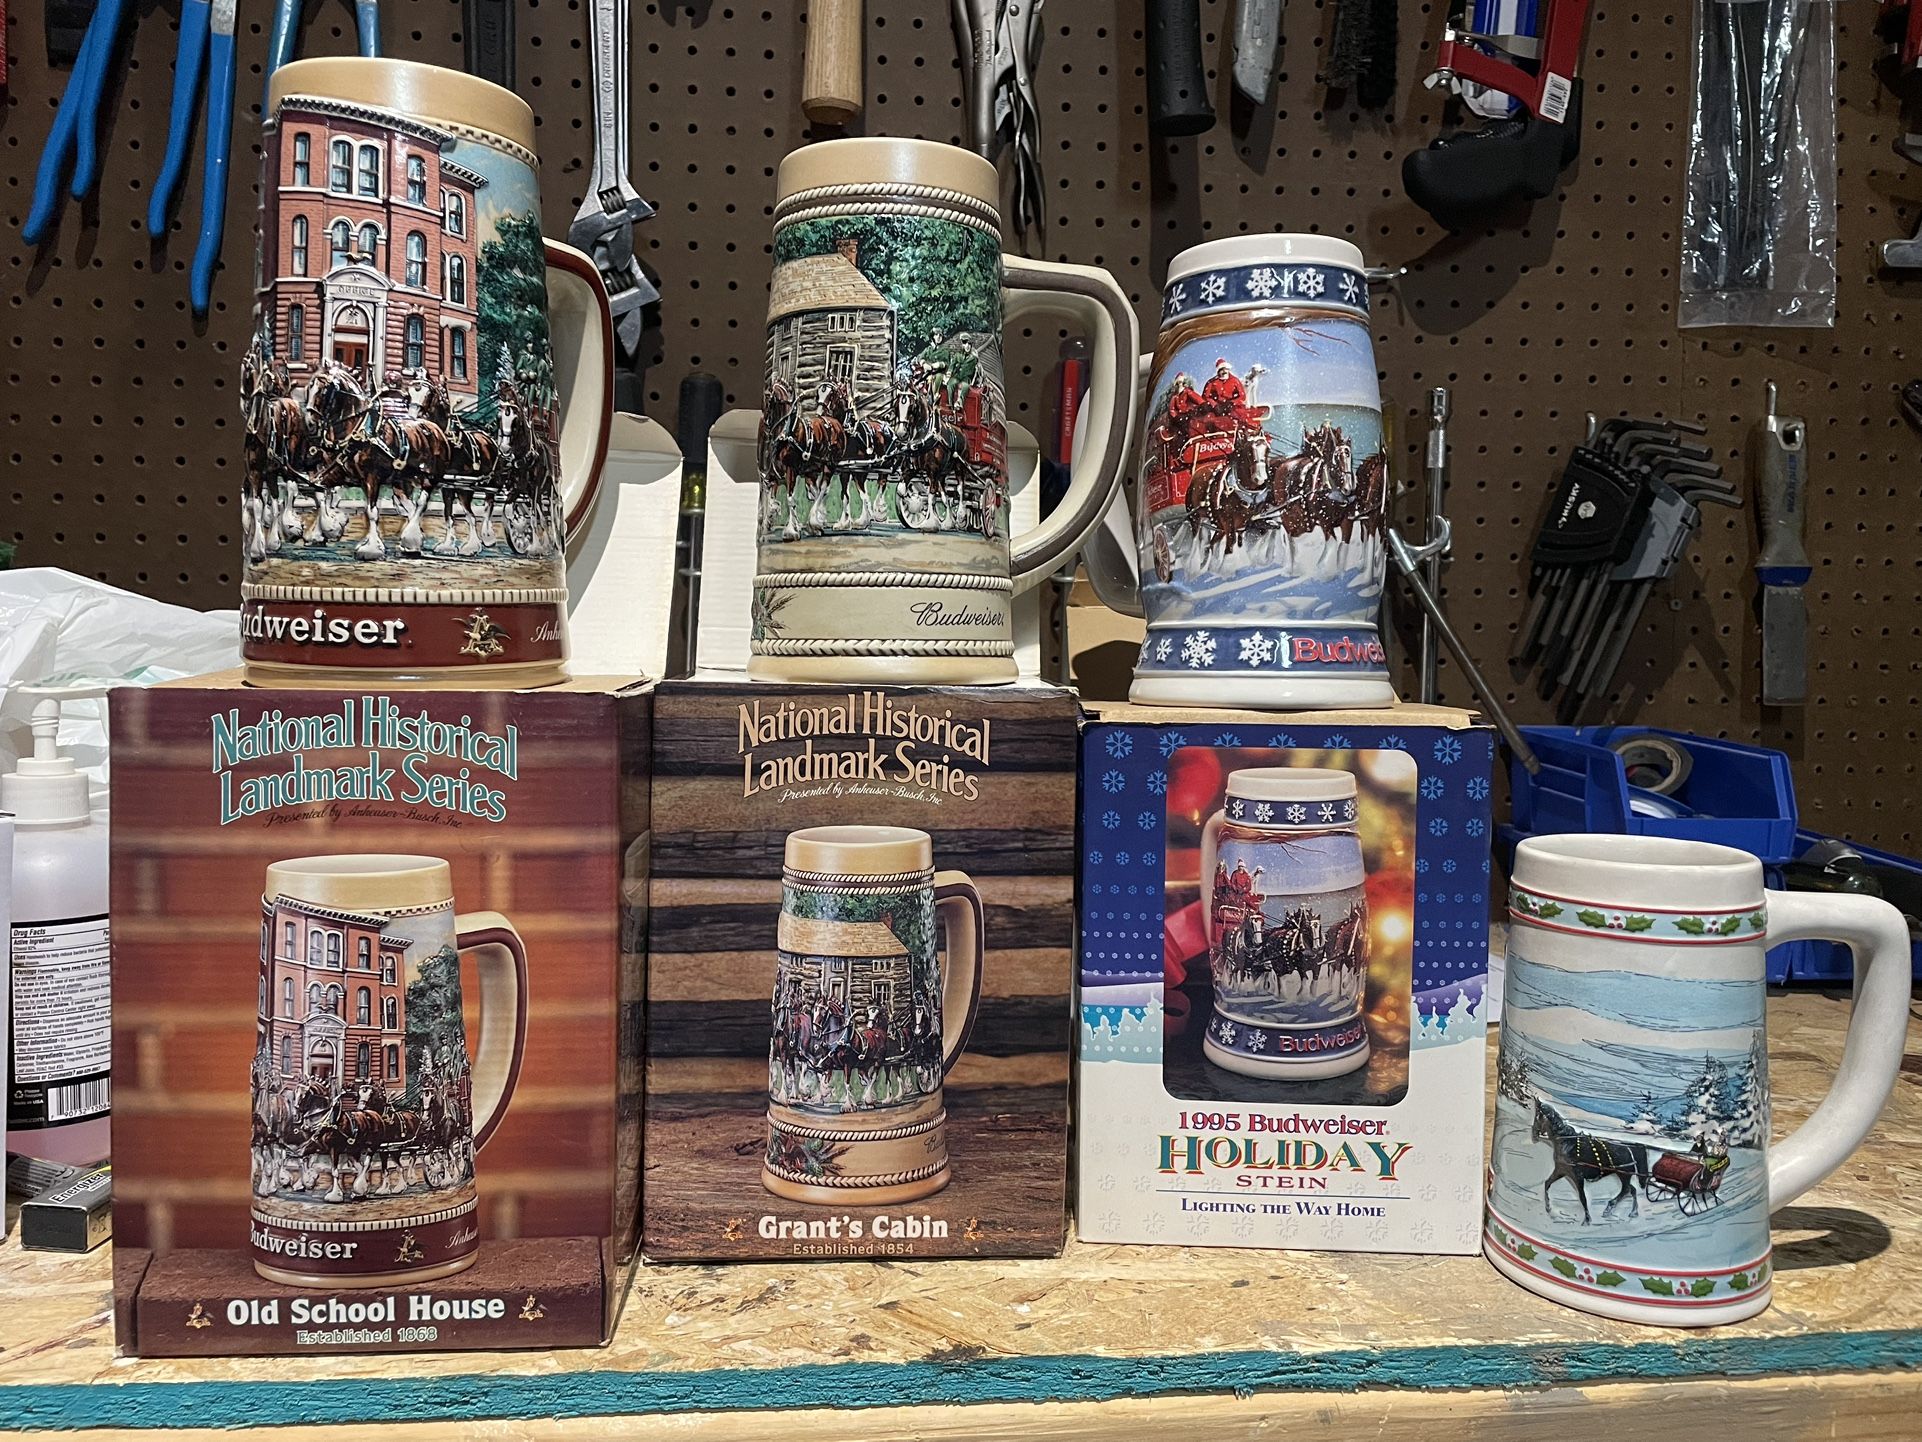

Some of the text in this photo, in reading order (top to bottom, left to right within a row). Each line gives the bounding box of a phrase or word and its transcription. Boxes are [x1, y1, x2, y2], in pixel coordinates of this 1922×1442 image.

[1063, 386, 1073, 437] CRAFTSMAN
[1562, 482, 1580, 517] HUSKY
[240, 603, 405, 644] udweiser
[910, 602, 1002, 626] Budweiser
[211, 696, 518, 781] National Historical
[738, 691, 990, 766] National Historical
[744, 738, 979, 801] Landmark Series
[220, 751, 506, 826] Landmark Series
[778, 782, 834, 803] Presented
[833, 782, 843, 798] by
[264, 803, 327, 828] Presented
[328, 804, 342, 822] by
[13, 929, 27, 937] Drug
[48, 1070, 75, 1079] Comments?
[1178, 1111, 1388, 1136] 1995 Budweiser
[1156, 1134, 1413, 1181] HOLIDAY
[50, 1171, 105, 1204] Energizer
[1236, 1175, 1327, 1189] STEIN
[1181, 1198, 1256, 1214] LIGHTING
[758, 1215, 949, 1239] Grant's Cabin
[793, 1243, 914, 1255] Established 1854
[226, 1295, 506, 1326] Old School House
[296, 1326, 438, 1345] Established 1868
